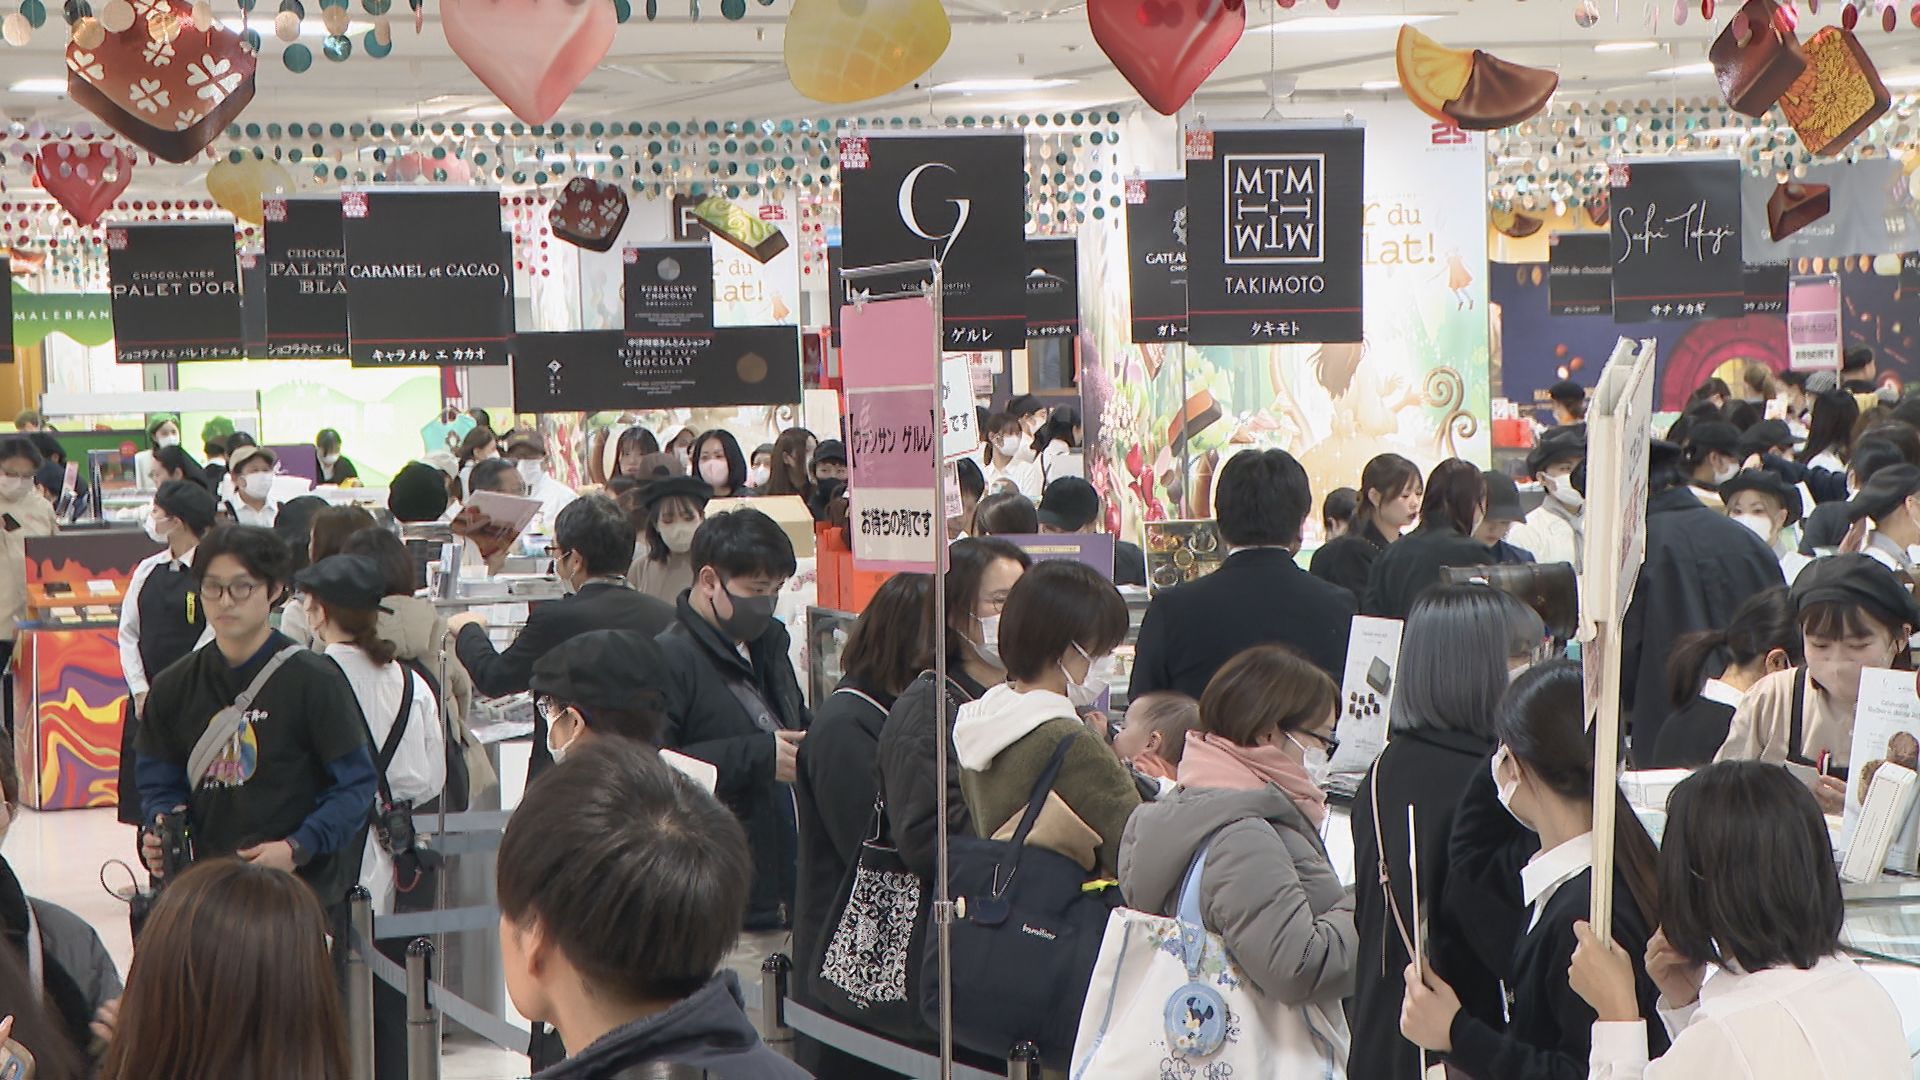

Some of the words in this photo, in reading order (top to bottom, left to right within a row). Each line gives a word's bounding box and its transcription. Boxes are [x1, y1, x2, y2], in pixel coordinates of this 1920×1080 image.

[1387, 203, 1423, 226] du
[132, 271, 215, 280] CHOCOLATIER
[270, 263, 347, 276] PALET
[350, 264, 426, 278] CARAMEL
[429, 267, 442, 277] et
[446, 263, 500, 277] CACAO
[728, 260, 752, 276] du
[113, 283, 182, 299] PALET
[189, 280, 236, 295] D'OR
[1224, 276, 1325, 294] TAKIMOTO
[645, 292, 693, 301] CHOCOLAT
[13, 310, 109, 321] MALEBRAN
[951, 328, 993, 343] ゲルレ
[1251, 321, 1300, 336] タキモト
[371, 349, 431, 362] キャラメル
[435, 351, 449, 360] エ
[453, 347, 487, 360] カカオ
[624, 358, 692, 367] CHOCOLAT
[861, 507, 932, 538] お待ちの列です
